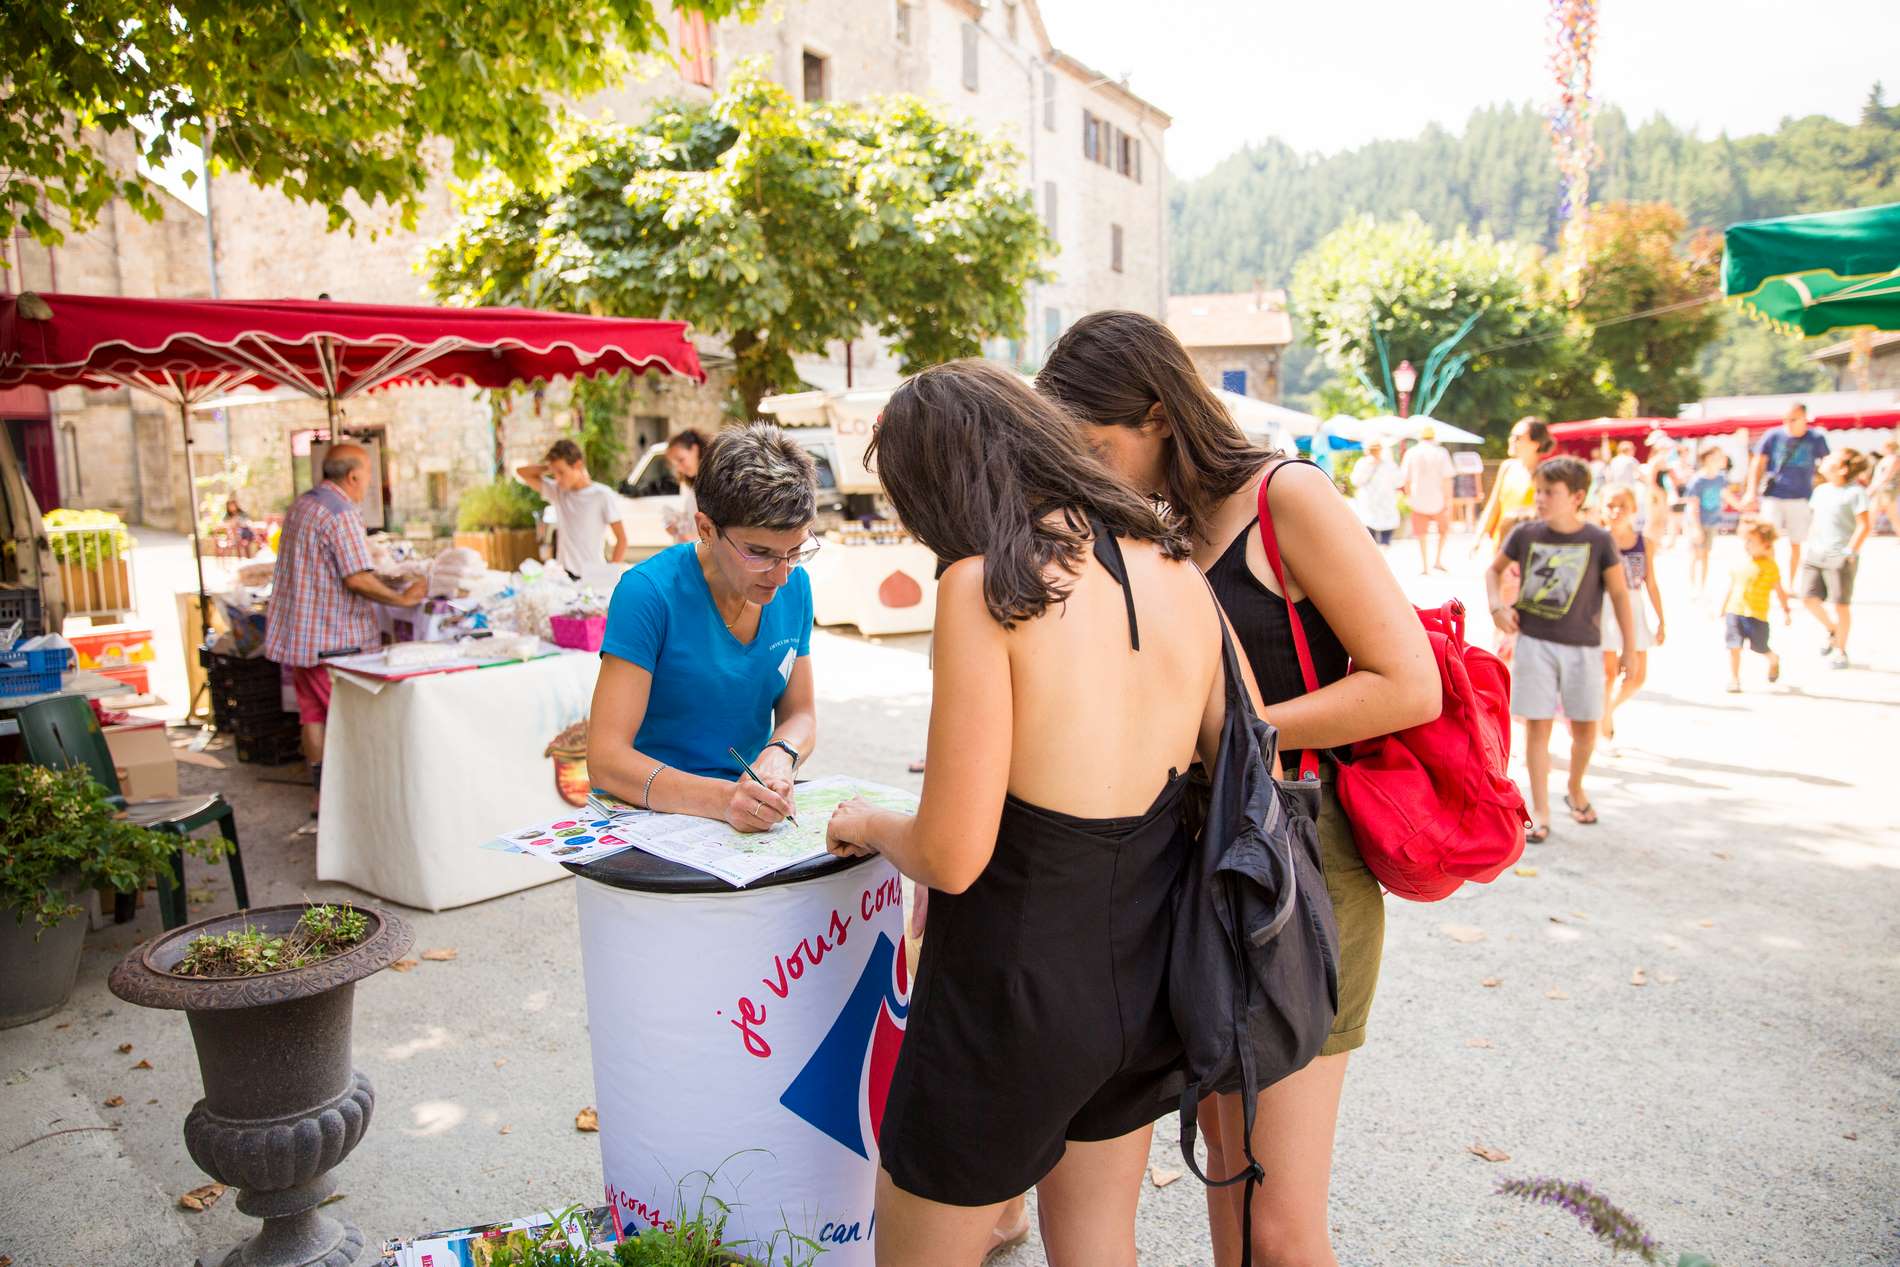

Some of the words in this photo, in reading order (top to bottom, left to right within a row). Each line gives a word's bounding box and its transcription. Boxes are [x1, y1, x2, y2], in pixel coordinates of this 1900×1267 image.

[718, 996, 772, 1058] je
[762, 909, 851, 998] vous
[819, 1221, 862, 1244] can
